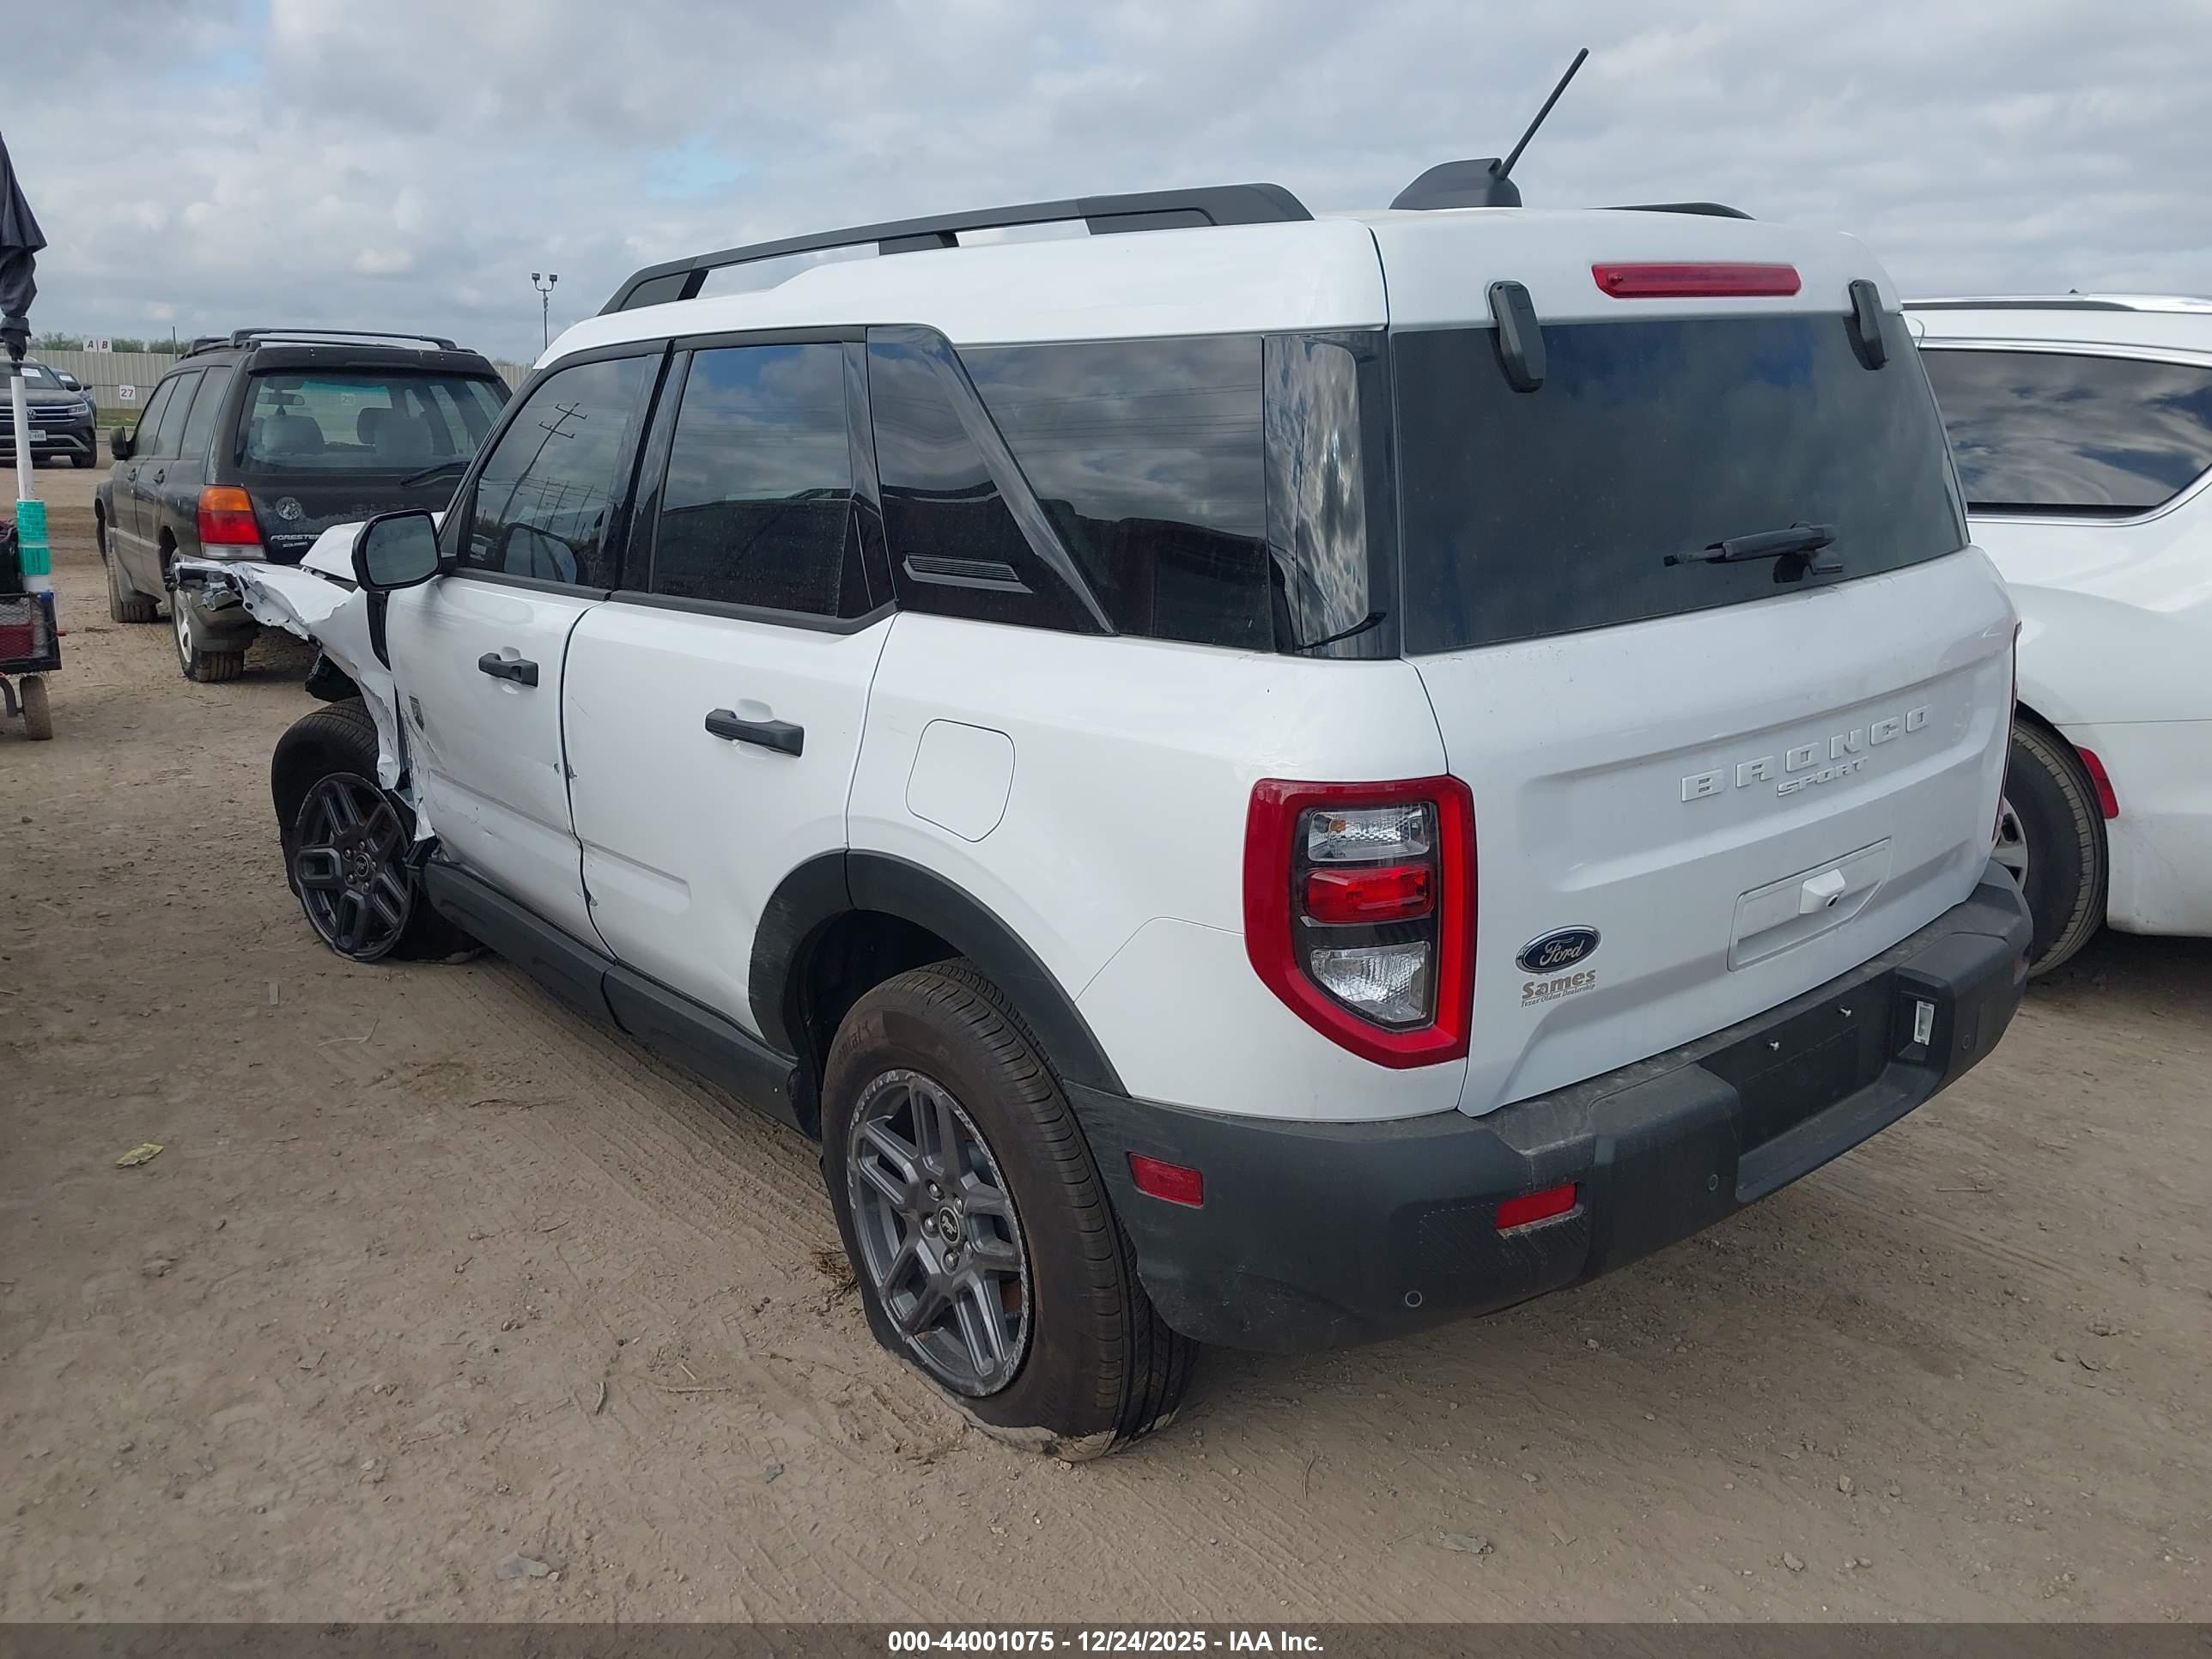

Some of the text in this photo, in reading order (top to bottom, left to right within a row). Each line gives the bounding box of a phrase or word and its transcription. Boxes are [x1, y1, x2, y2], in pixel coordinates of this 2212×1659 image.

[88, 340, 94, 349] A
[101, 340, 108, 349] B
[120, 388, 134, 398] 27
[1680, 703, 1932, 803] BRONCO
[1777, 756, 1869, 798] SPORT
[1540, 937, 1585, 966] Ford
[1522, 969, 1596, 1000] Sames
[1540, 992, 1561, 1003] Oldest
[1563, 984, 1595, 997] Dealership
